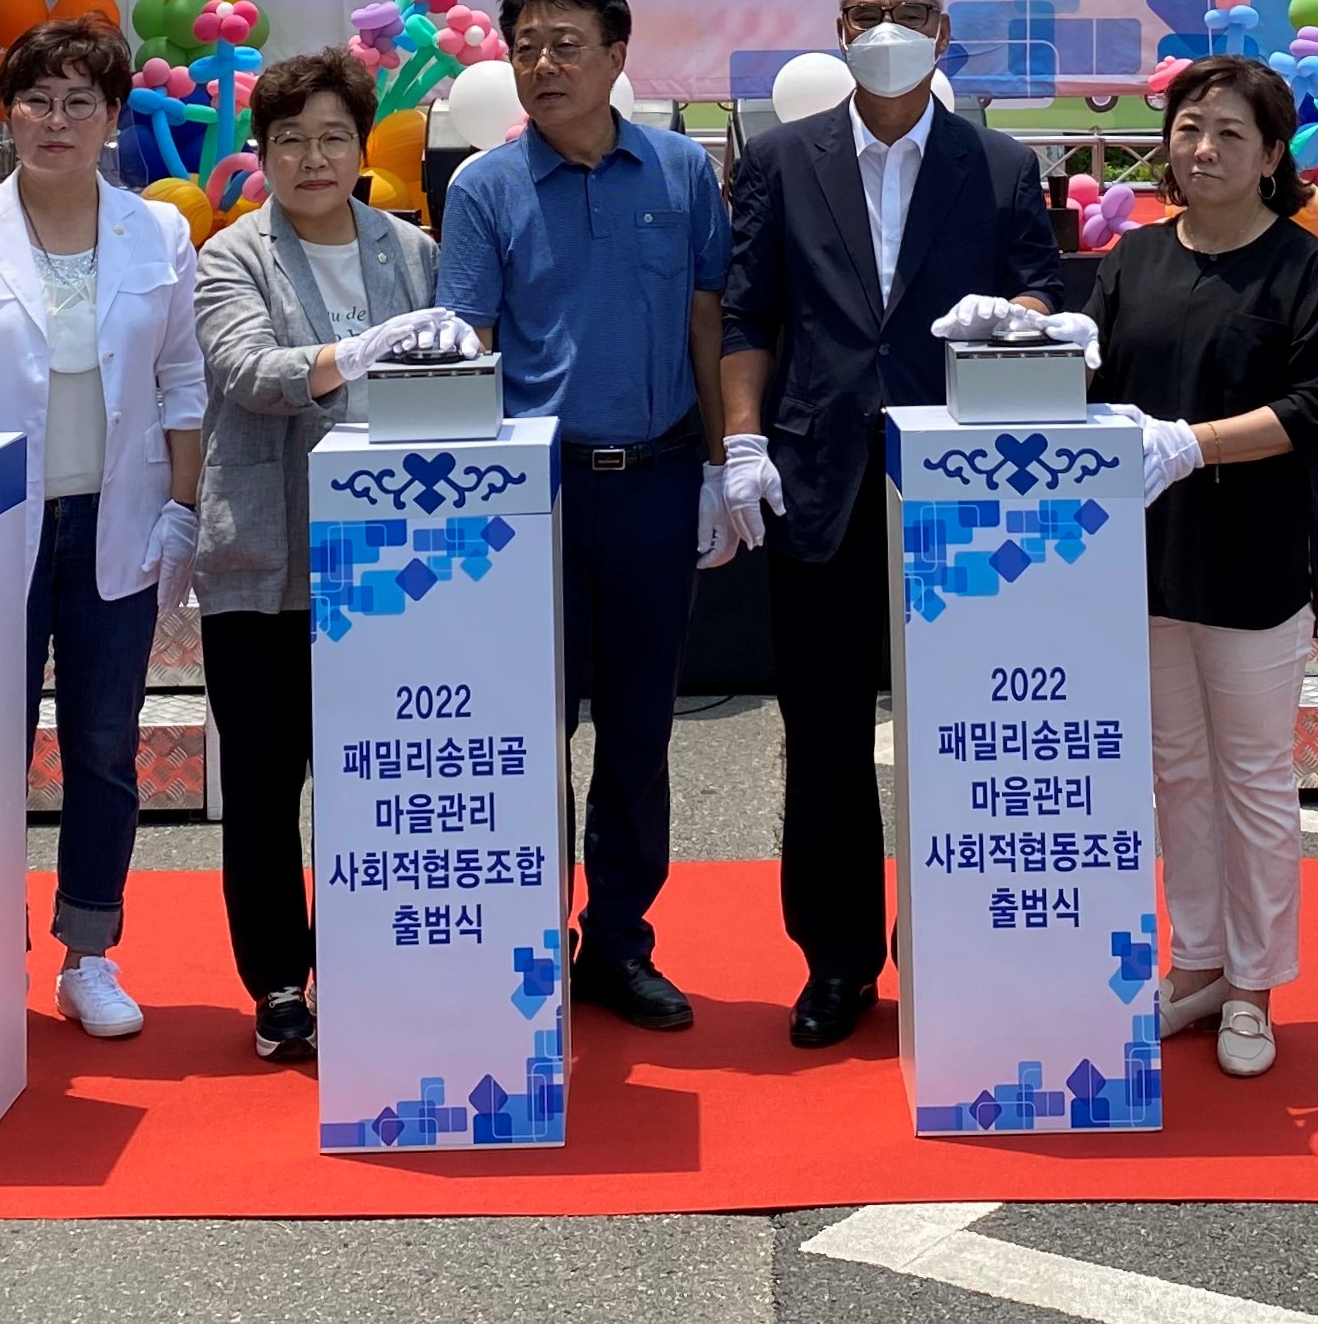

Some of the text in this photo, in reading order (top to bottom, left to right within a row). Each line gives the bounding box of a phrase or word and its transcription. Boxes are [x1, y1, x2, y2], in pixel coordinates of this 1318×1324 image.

[346, 305, 366, 322] de
[396, 684, 472, 720] 2022
[991, 666, 1067, 702] 2022
[343, 736, 527, 781] 패밀리송림골
[938, 719, 1123, 762] 패밀리송림골
[375, 791, 495, 835] 마을관리
[971, 775, 1092, 817] 마을관리
[329, 846, 545, 892] 사회적협동조합
[925, 830, 1142, 874] 사회적협동조합
[392, 903, 483, 946] 출범식
[988, 887, 1080, 929] 출범식
